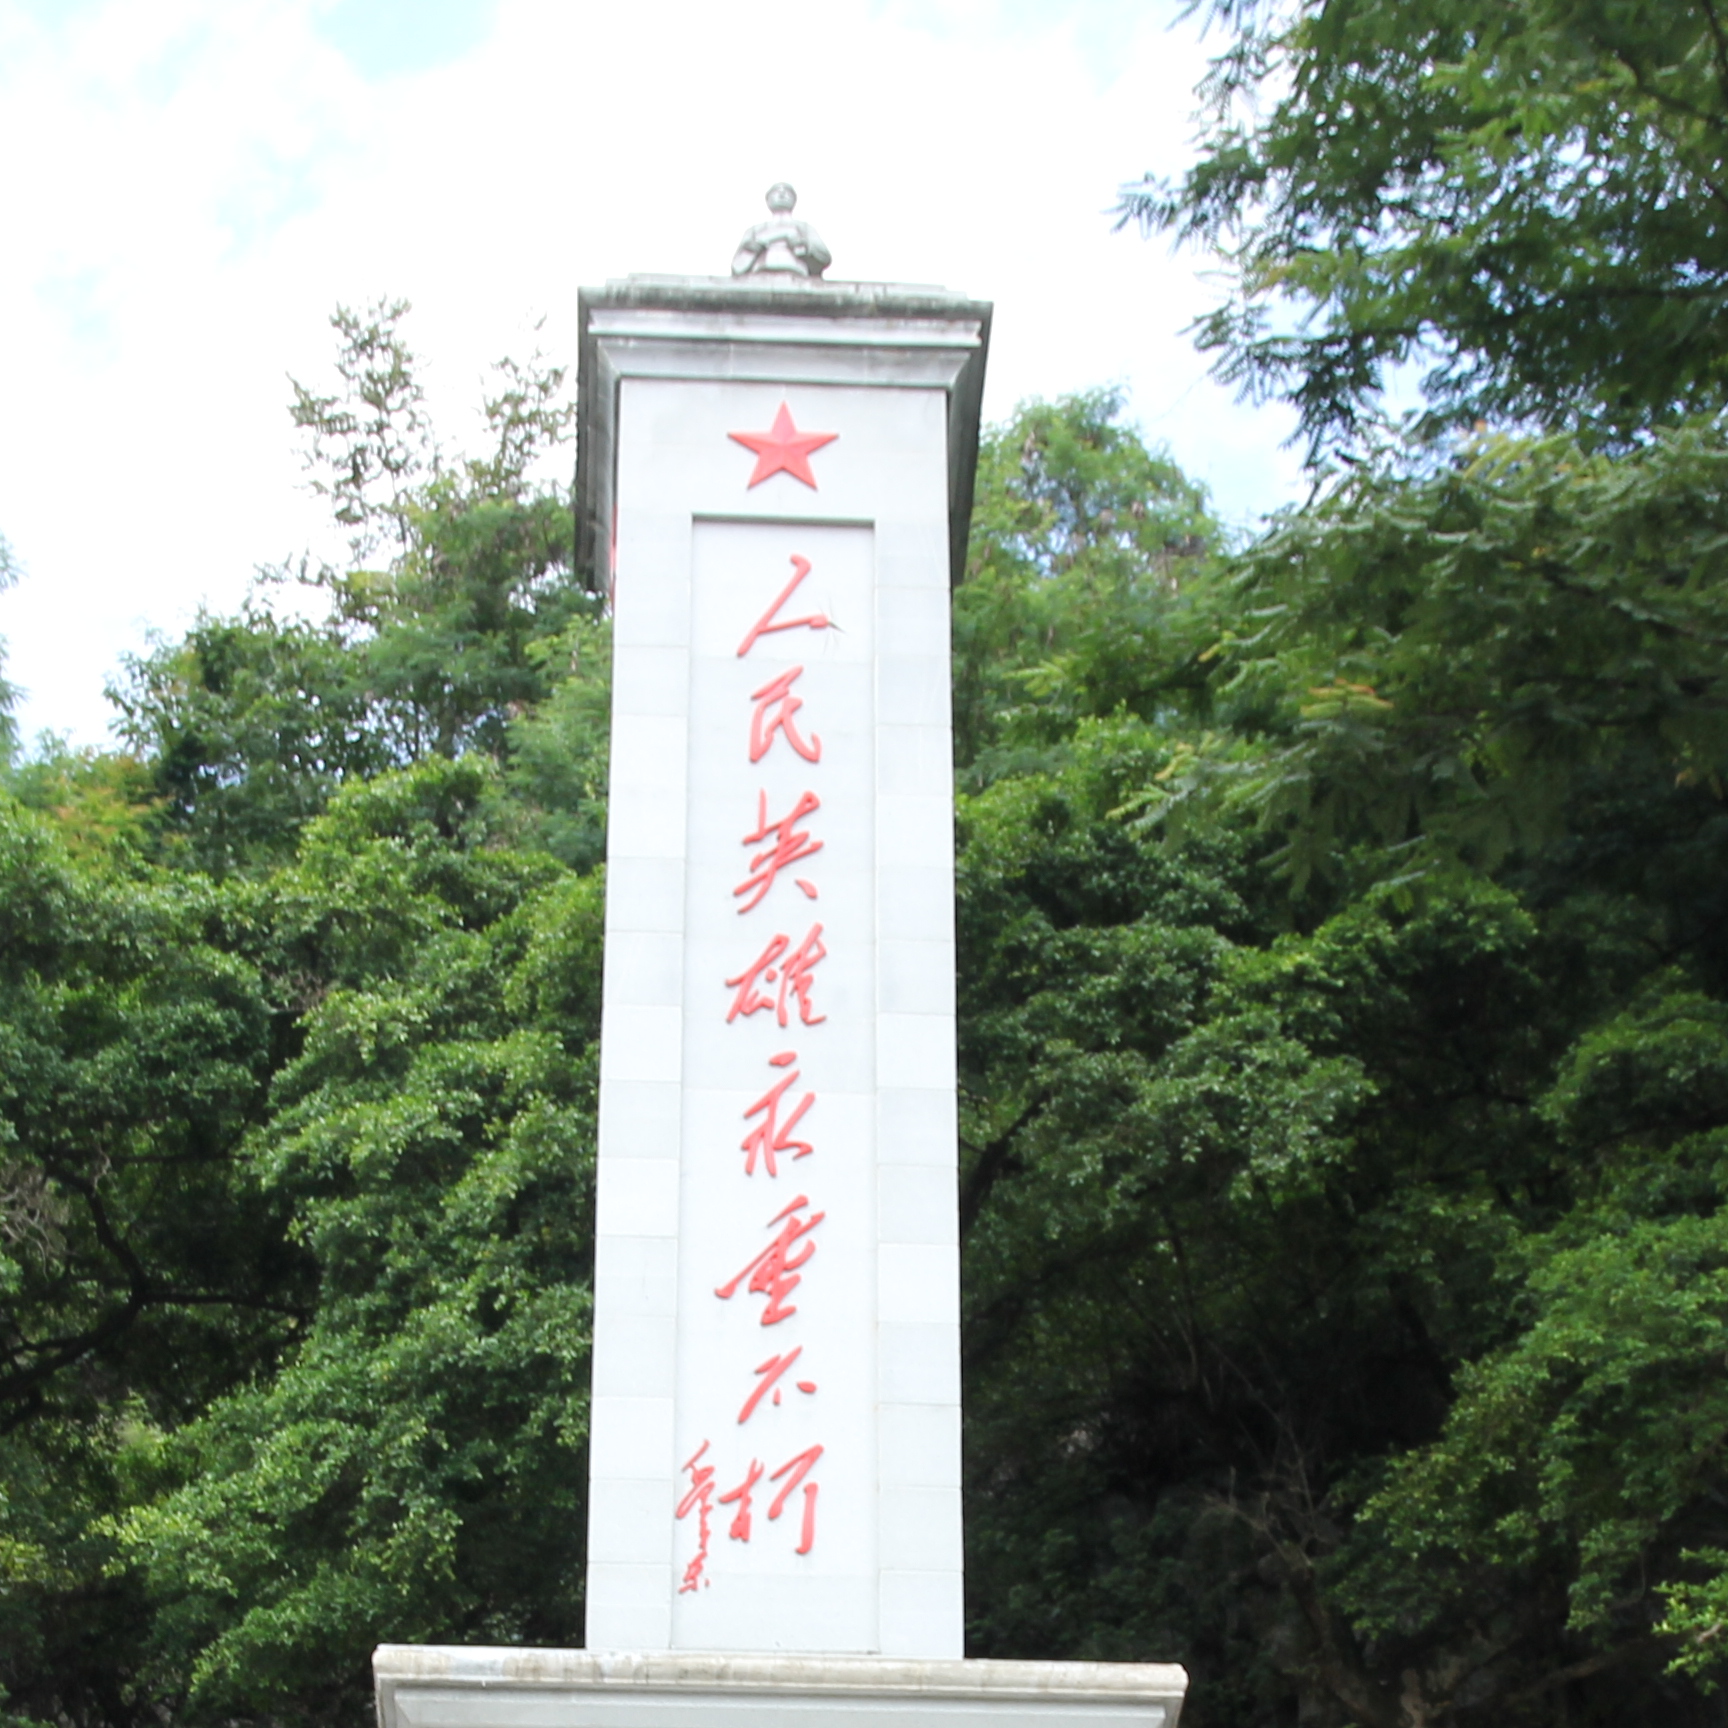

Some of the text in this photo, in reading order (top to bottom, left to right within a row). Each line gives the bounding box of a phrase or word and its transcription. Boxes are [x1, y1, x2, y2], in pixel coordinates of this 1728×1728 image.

[714, 554, 830, 1556] 人民英雄永垂不朽
